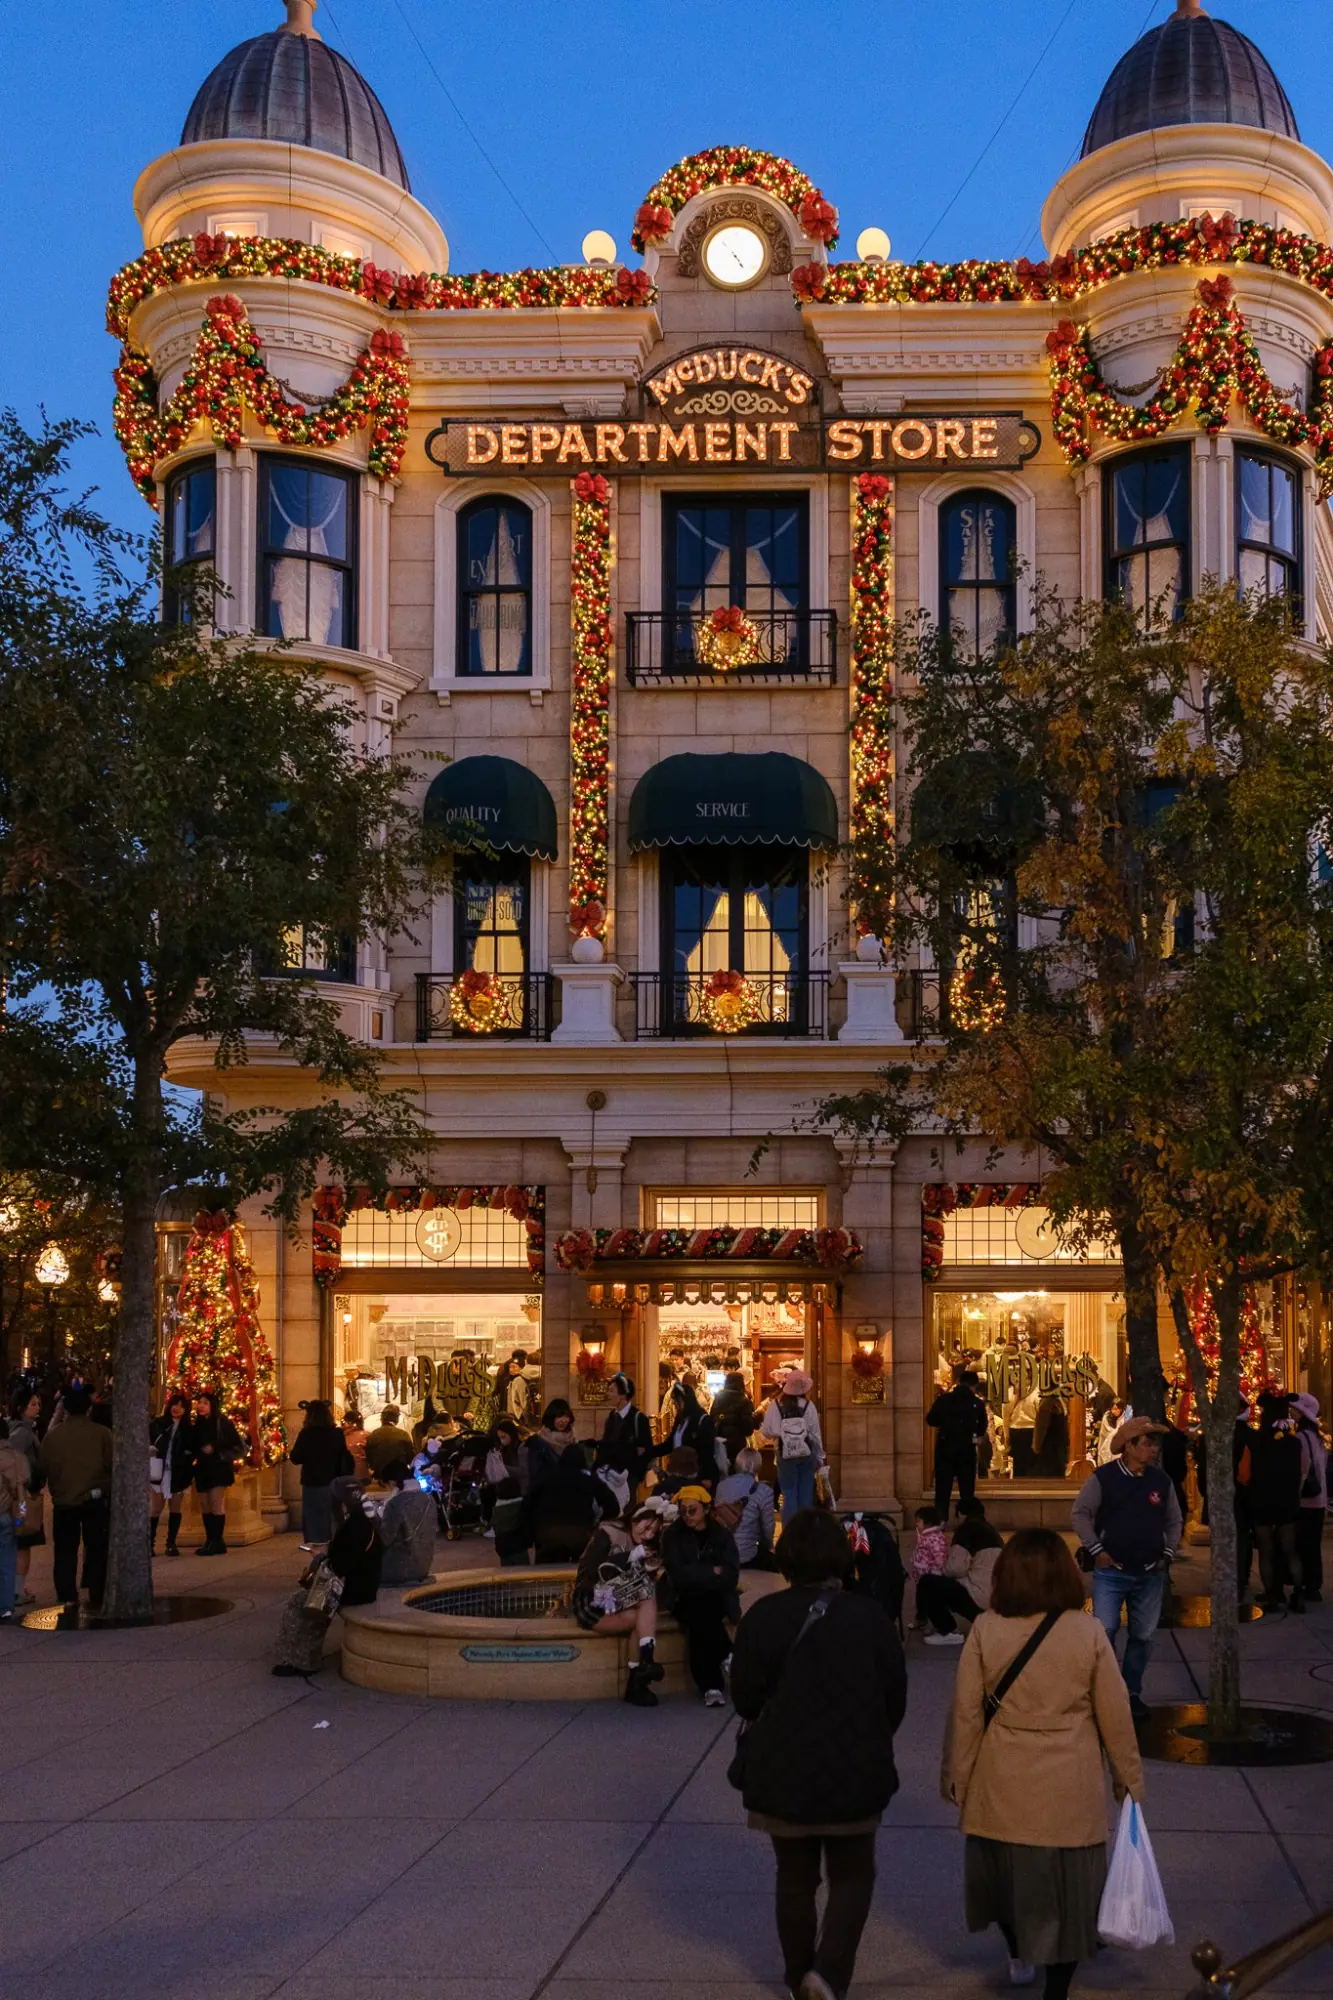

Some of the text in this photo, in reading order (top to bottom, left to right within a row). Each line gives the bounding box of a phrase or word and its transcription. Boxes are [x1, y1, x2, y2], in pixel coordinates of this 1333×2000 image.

[645, 350, 815, 406] McDUCK'S
[466, 419, 999, 464] DEPARTMENT STORE
[470, 533, 525, 582] EXRT
[446, 804, 501, 824] QUALITY
[695, 802, 750, 818] SERVICE
